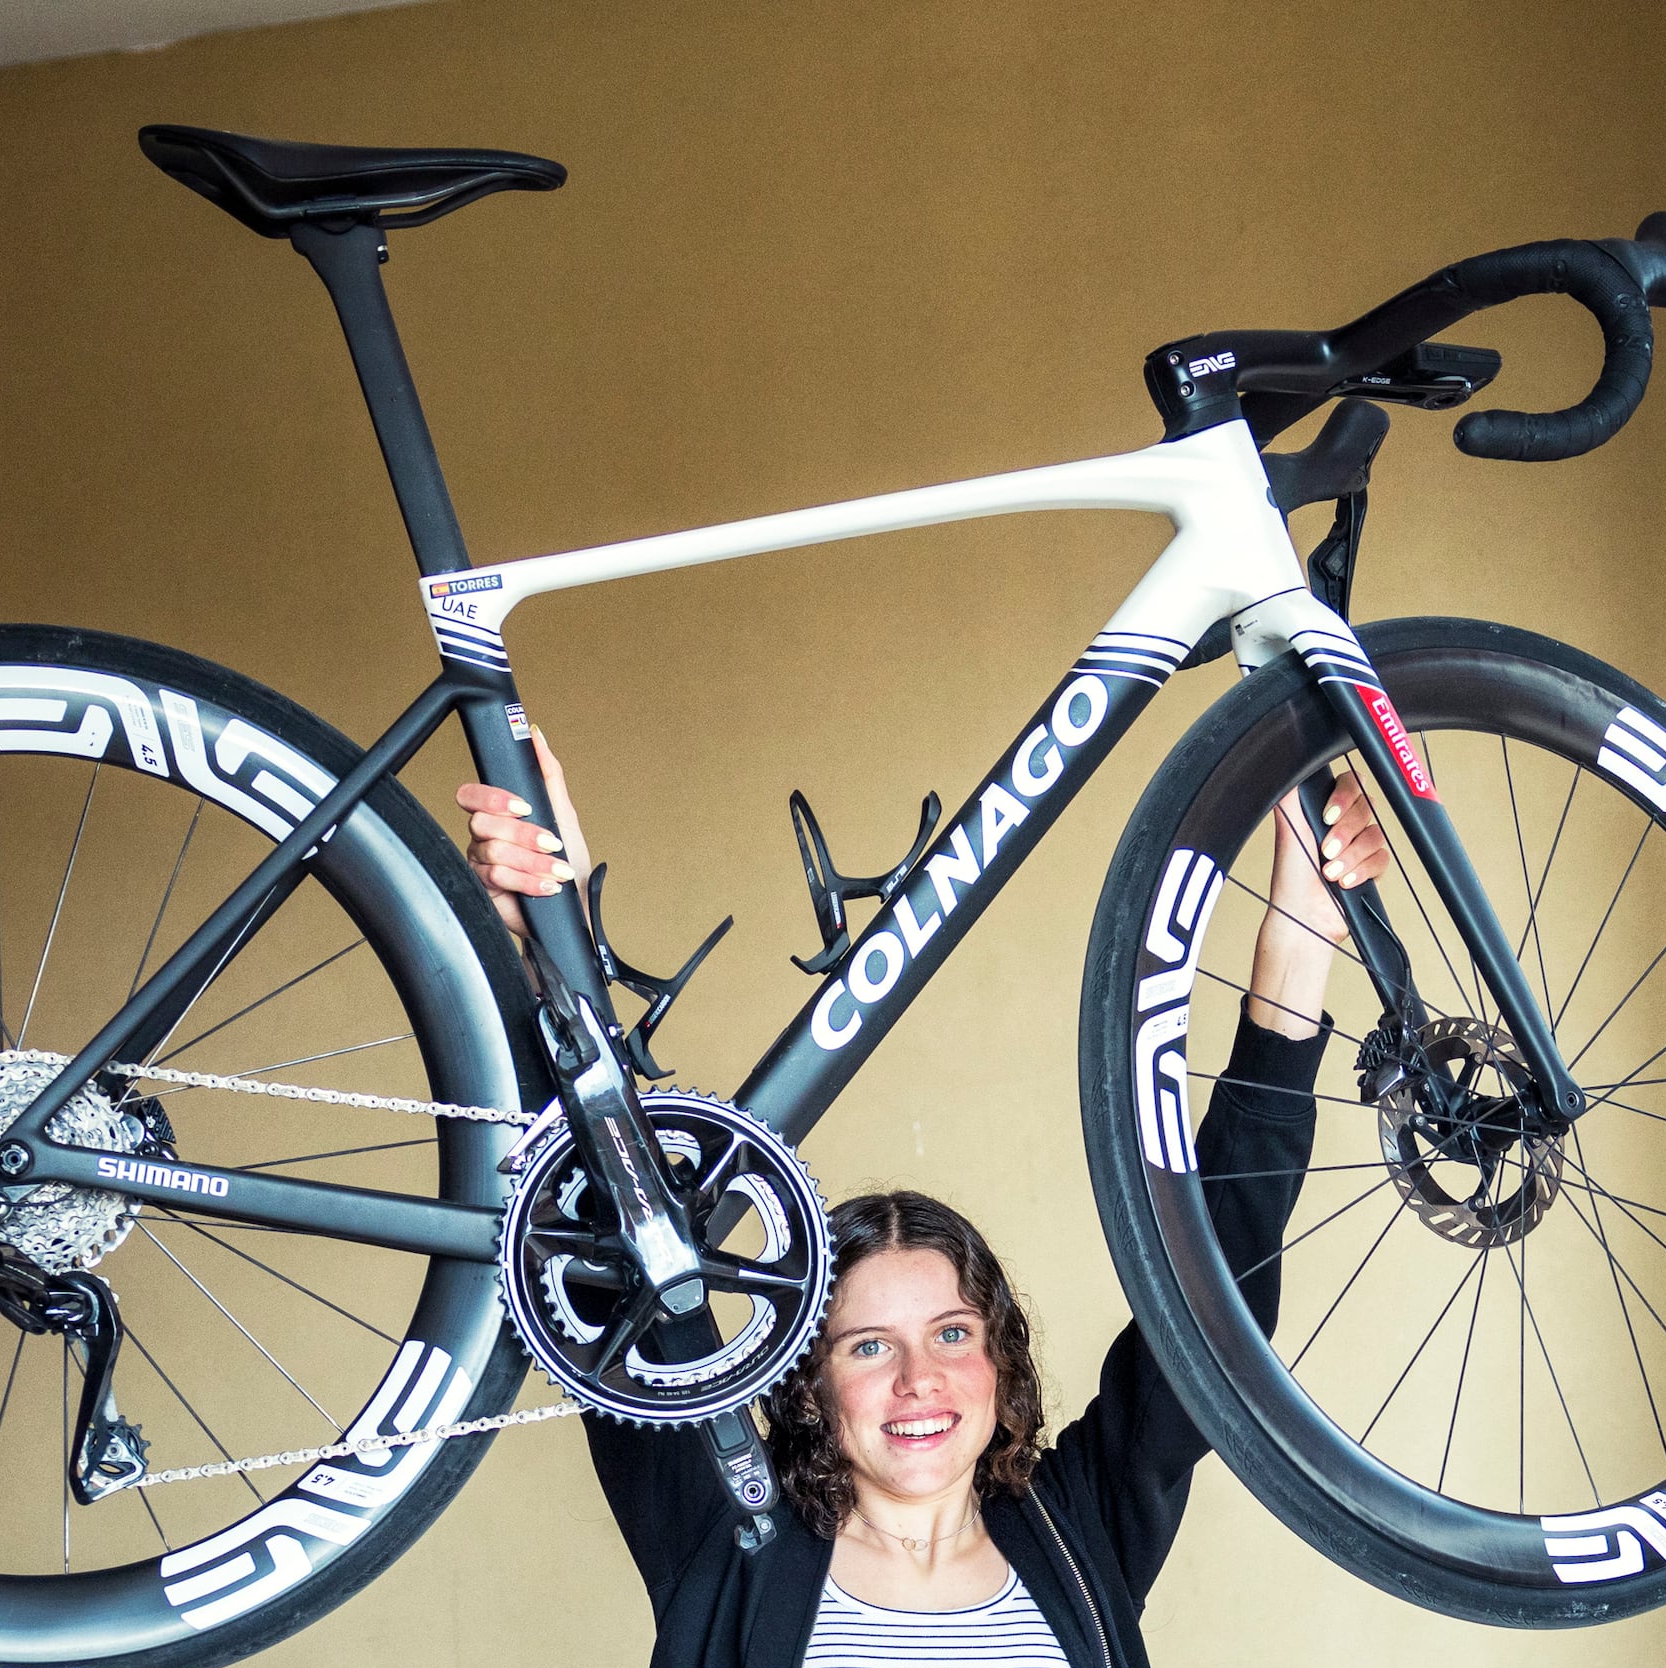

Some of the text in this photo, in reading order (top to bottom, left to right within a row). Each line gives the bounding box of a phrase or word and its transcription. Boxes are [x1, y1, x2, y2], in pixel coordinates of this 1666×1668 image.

[1362, 376, 1392, 385] K-EDGE
[449, 576, 499, 593] TORRES
[442, 597, 479, 620] UAE
[141, 743, 158, 767] 4.5
[1371, 696, 1429, 792] Emirates
[810, 674, 1109, 1050] COLNAGO
[97, 1156, 230, 1197] SHIMANO
[310, 1473, 336, 1487] 4.5
